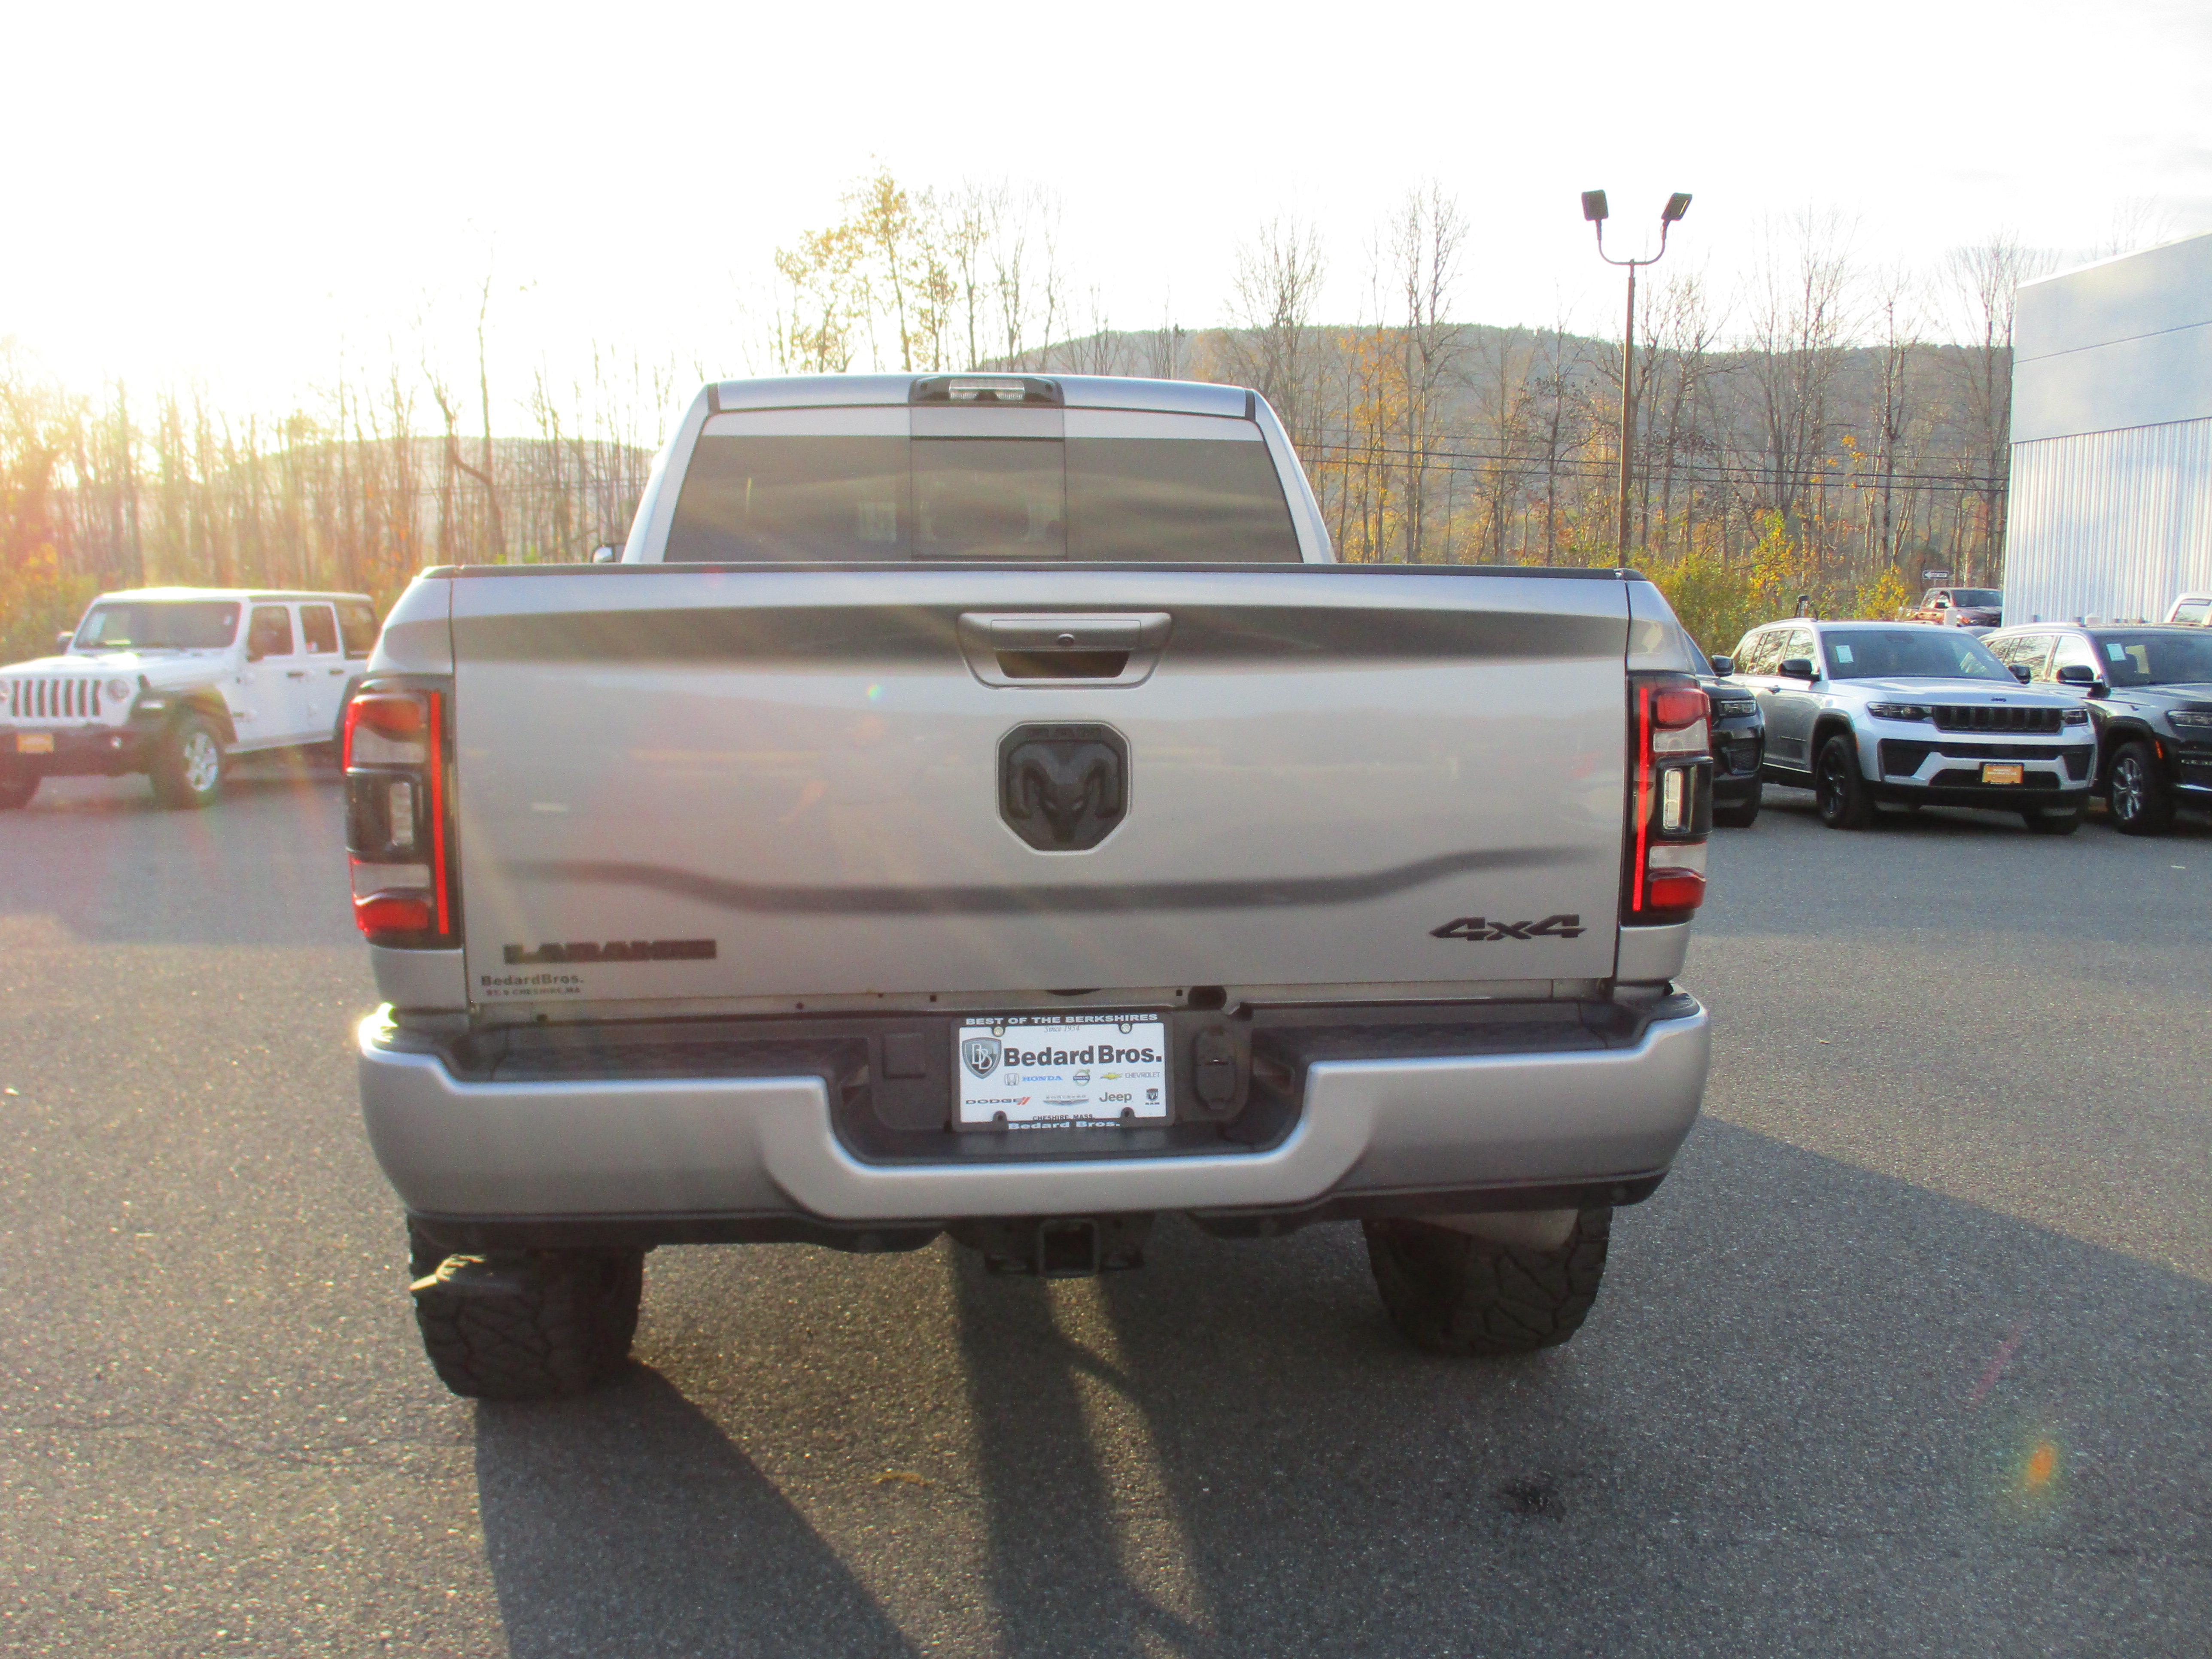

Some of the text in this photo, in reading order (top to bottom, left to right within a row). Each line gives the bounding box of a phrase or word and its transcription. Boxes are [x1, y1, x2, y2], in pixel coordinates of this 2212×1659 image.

[966, 1017, 1004, 1025] BEST
[1065, 1014, 1158, 1023] BERKSHIRES
[1004, 1045, 1162, 1066] Bedard Bros.
[1100, 1092, 1132, 1103] Jeep
